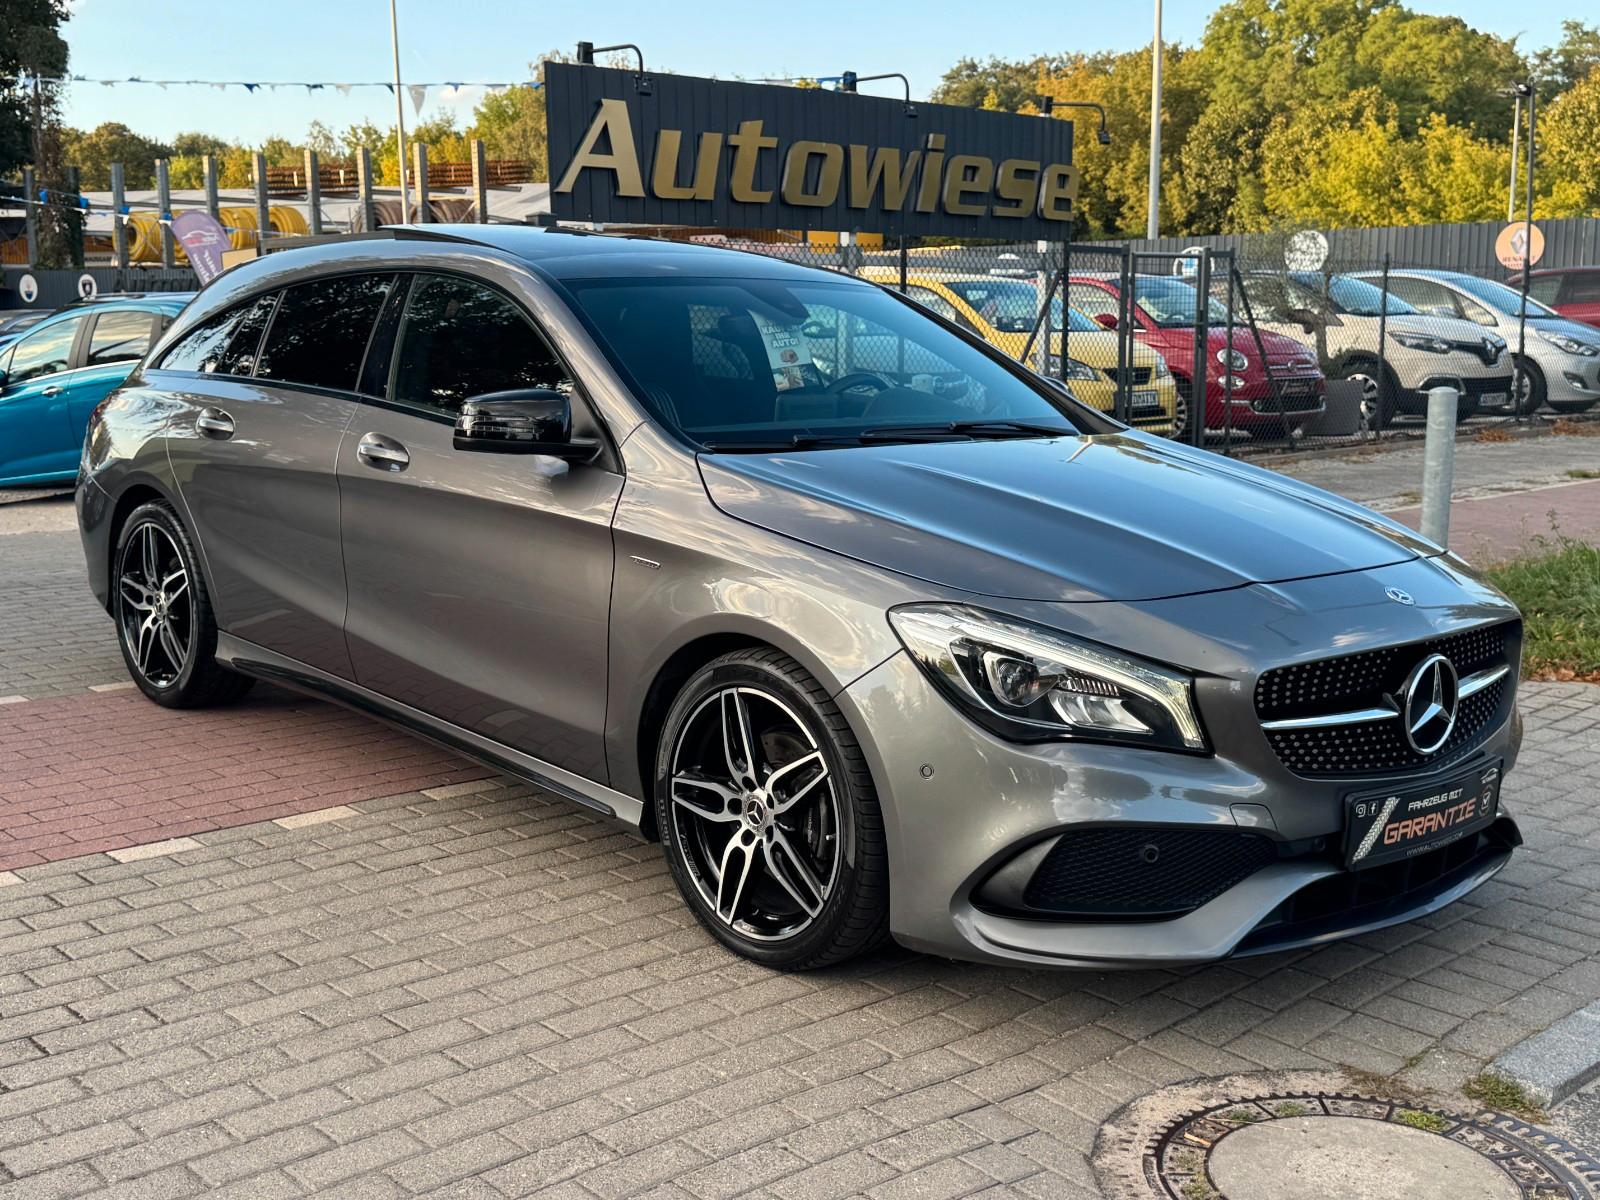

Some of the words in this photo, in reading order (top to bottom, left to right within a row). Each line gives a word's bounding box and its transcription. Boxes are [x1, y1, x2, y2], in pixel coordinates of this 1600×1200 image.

[553, 98, 1081, 221] Autowiese
[1383, 797, 1477, 845] GARANTIE
[1408, 793, 1448, 811] FAHRZEUG
[1449, 788, 1463, 800] MIT
